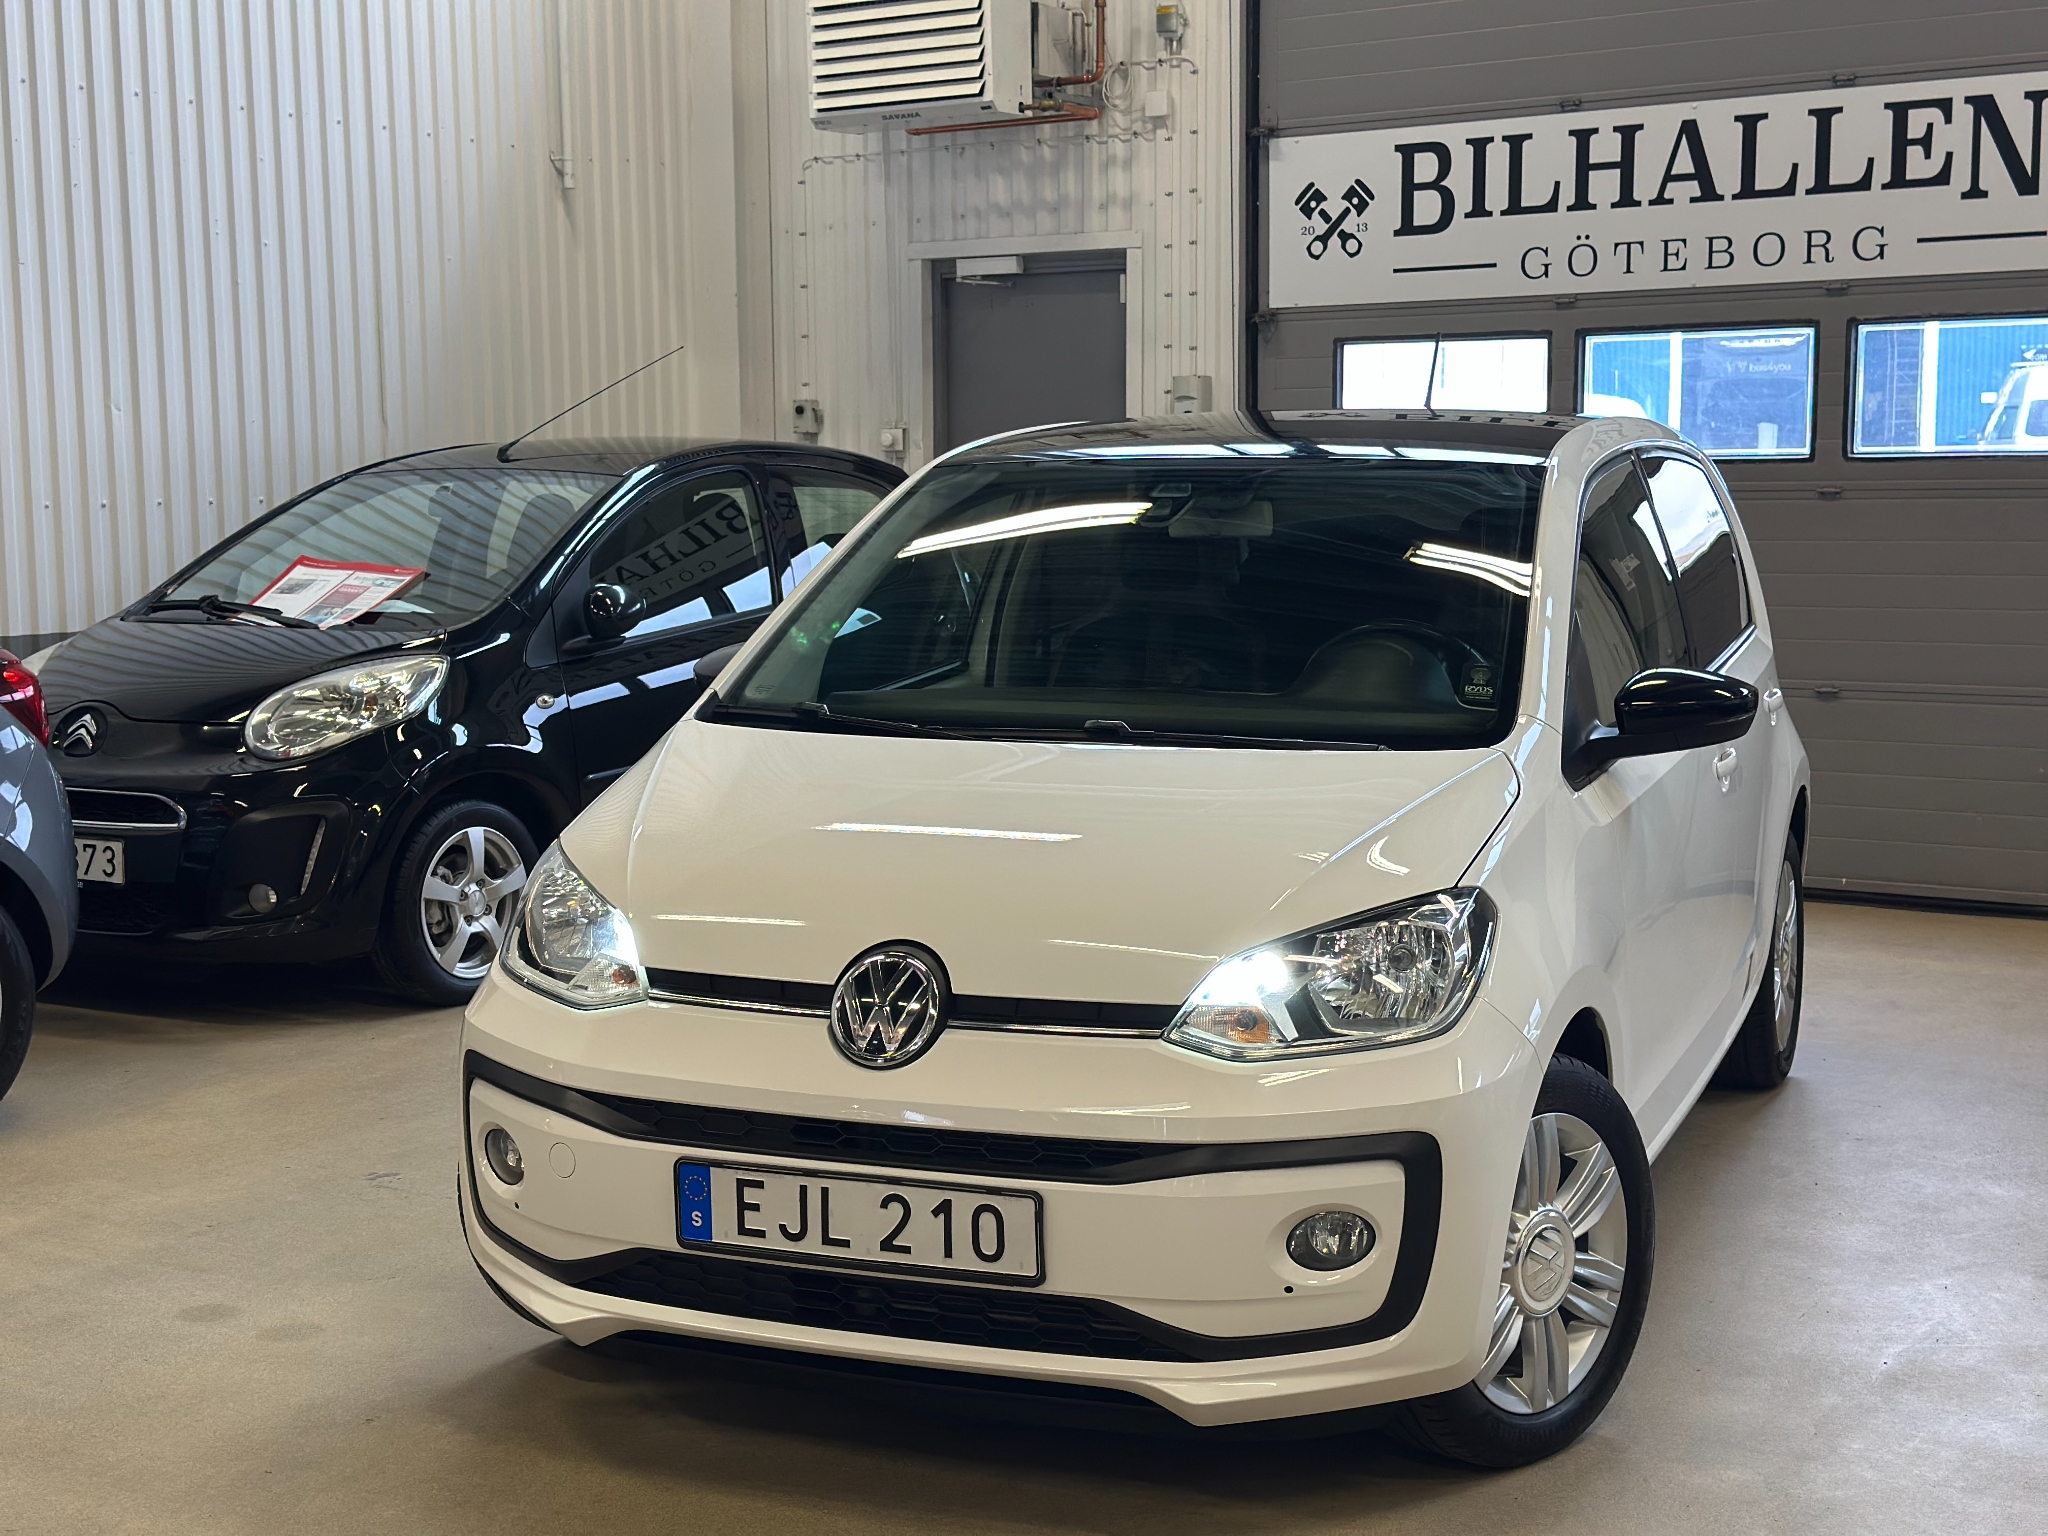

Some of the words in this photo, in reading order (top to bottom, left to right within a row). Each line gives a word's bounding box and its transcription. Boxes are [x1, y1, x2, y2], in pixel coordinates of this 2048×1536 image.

[881, 111, 922, 121] SAVANA
[1393, 90, 2048, 237] BILHALLEN
[1300, 225, 1316, 236] 20
[1356, 222, 1368, 233] 13
[1519, 225, 1890, 280] GÖTEBORG
[75, 843, 116, 878] 73
[691, 1211, 703, 1227] S
[735, 1177, 851, 1249] EJL
[879, 1193, 1005, 1264] 210
